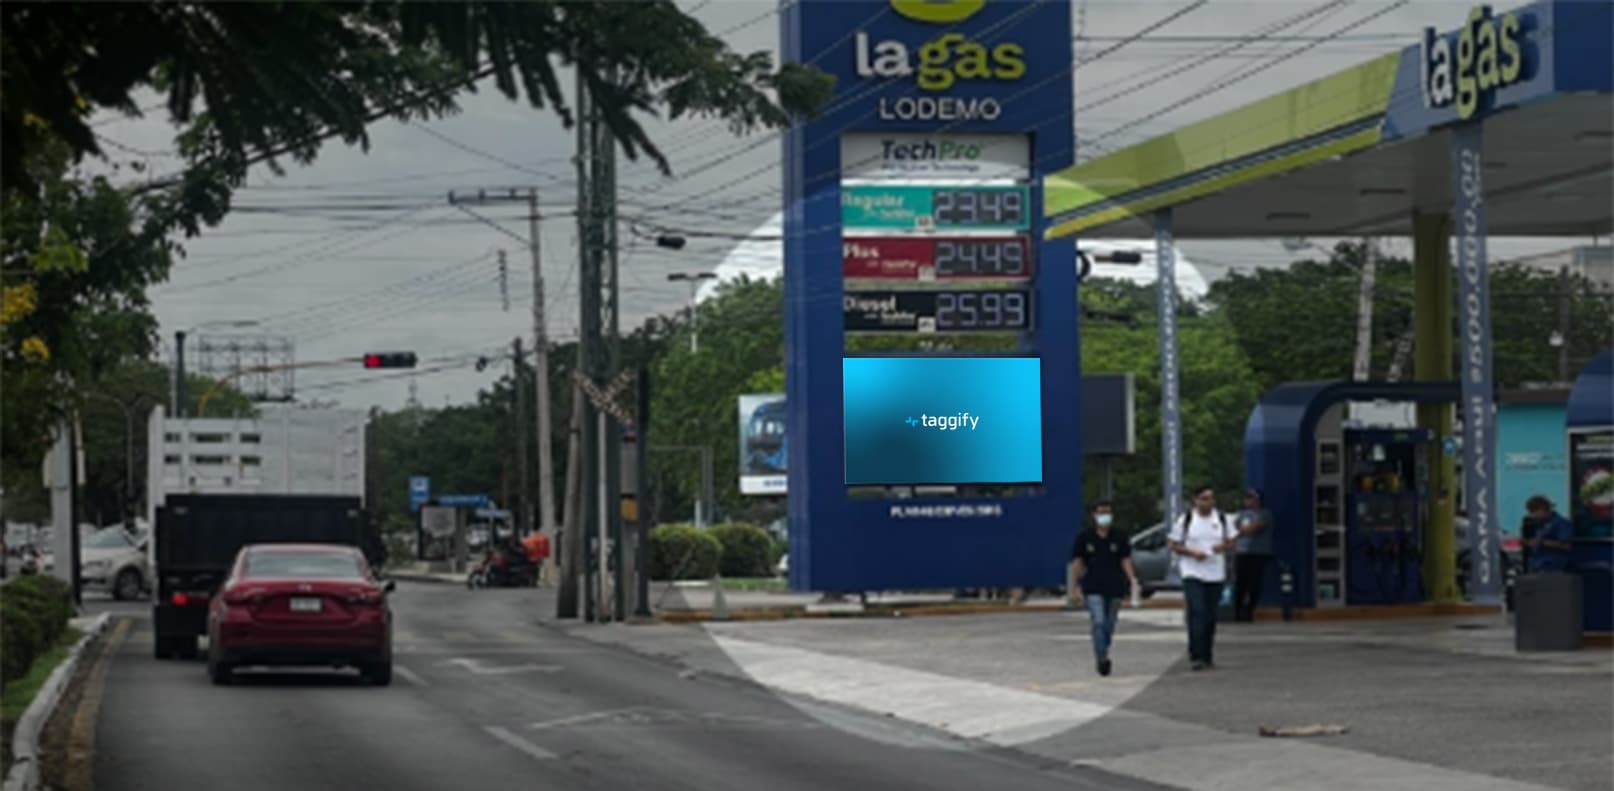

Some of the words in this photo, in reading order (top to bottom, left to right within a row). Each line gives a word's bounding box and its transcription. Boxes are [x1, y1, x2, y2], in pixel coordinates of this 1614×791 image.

[879, 98, 1001, 120] LODEMO
[842, 242, 880, 259] Plus
[921, 412, 980, 430] taggify
